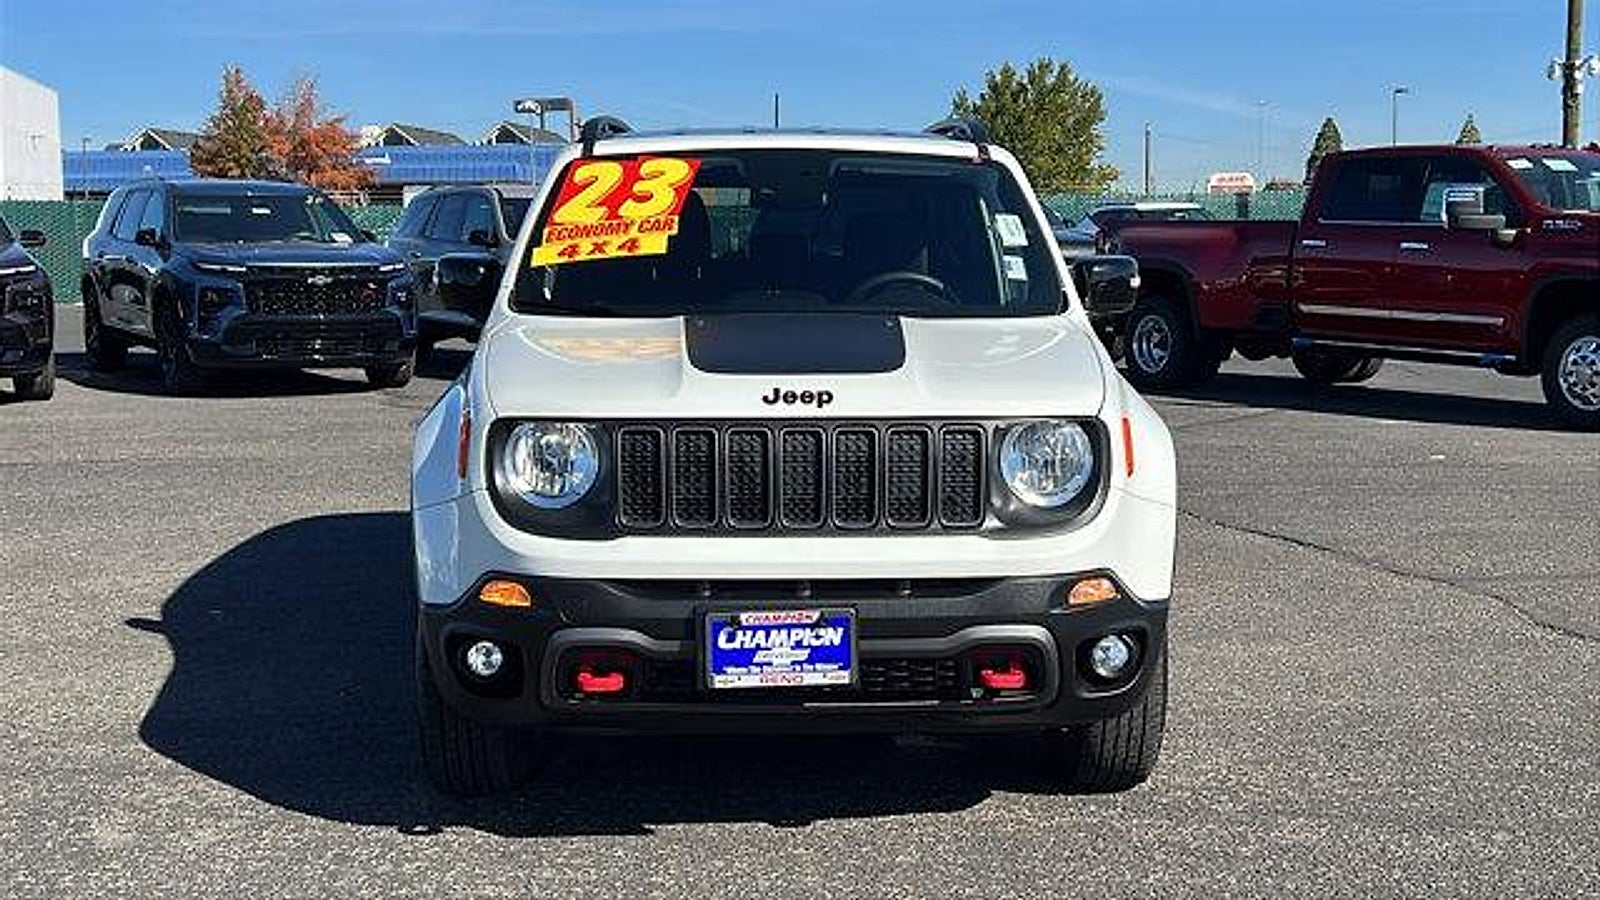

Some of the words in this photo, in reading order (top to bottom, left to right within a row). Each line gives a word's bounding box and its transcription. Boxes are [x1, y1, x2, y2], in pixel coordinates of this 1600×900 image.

[554, 158, 691, 223] 23
[546, 220, 633, 243] ECONOMY
[638, 216, 676, 233] CAR
[762, 387, 834, 408] Jeep
[745, 612, 814, 623] CHAMPION
[717, 627, 844, 650] CHAMPION
[760, 674, 804, 684] RENO
